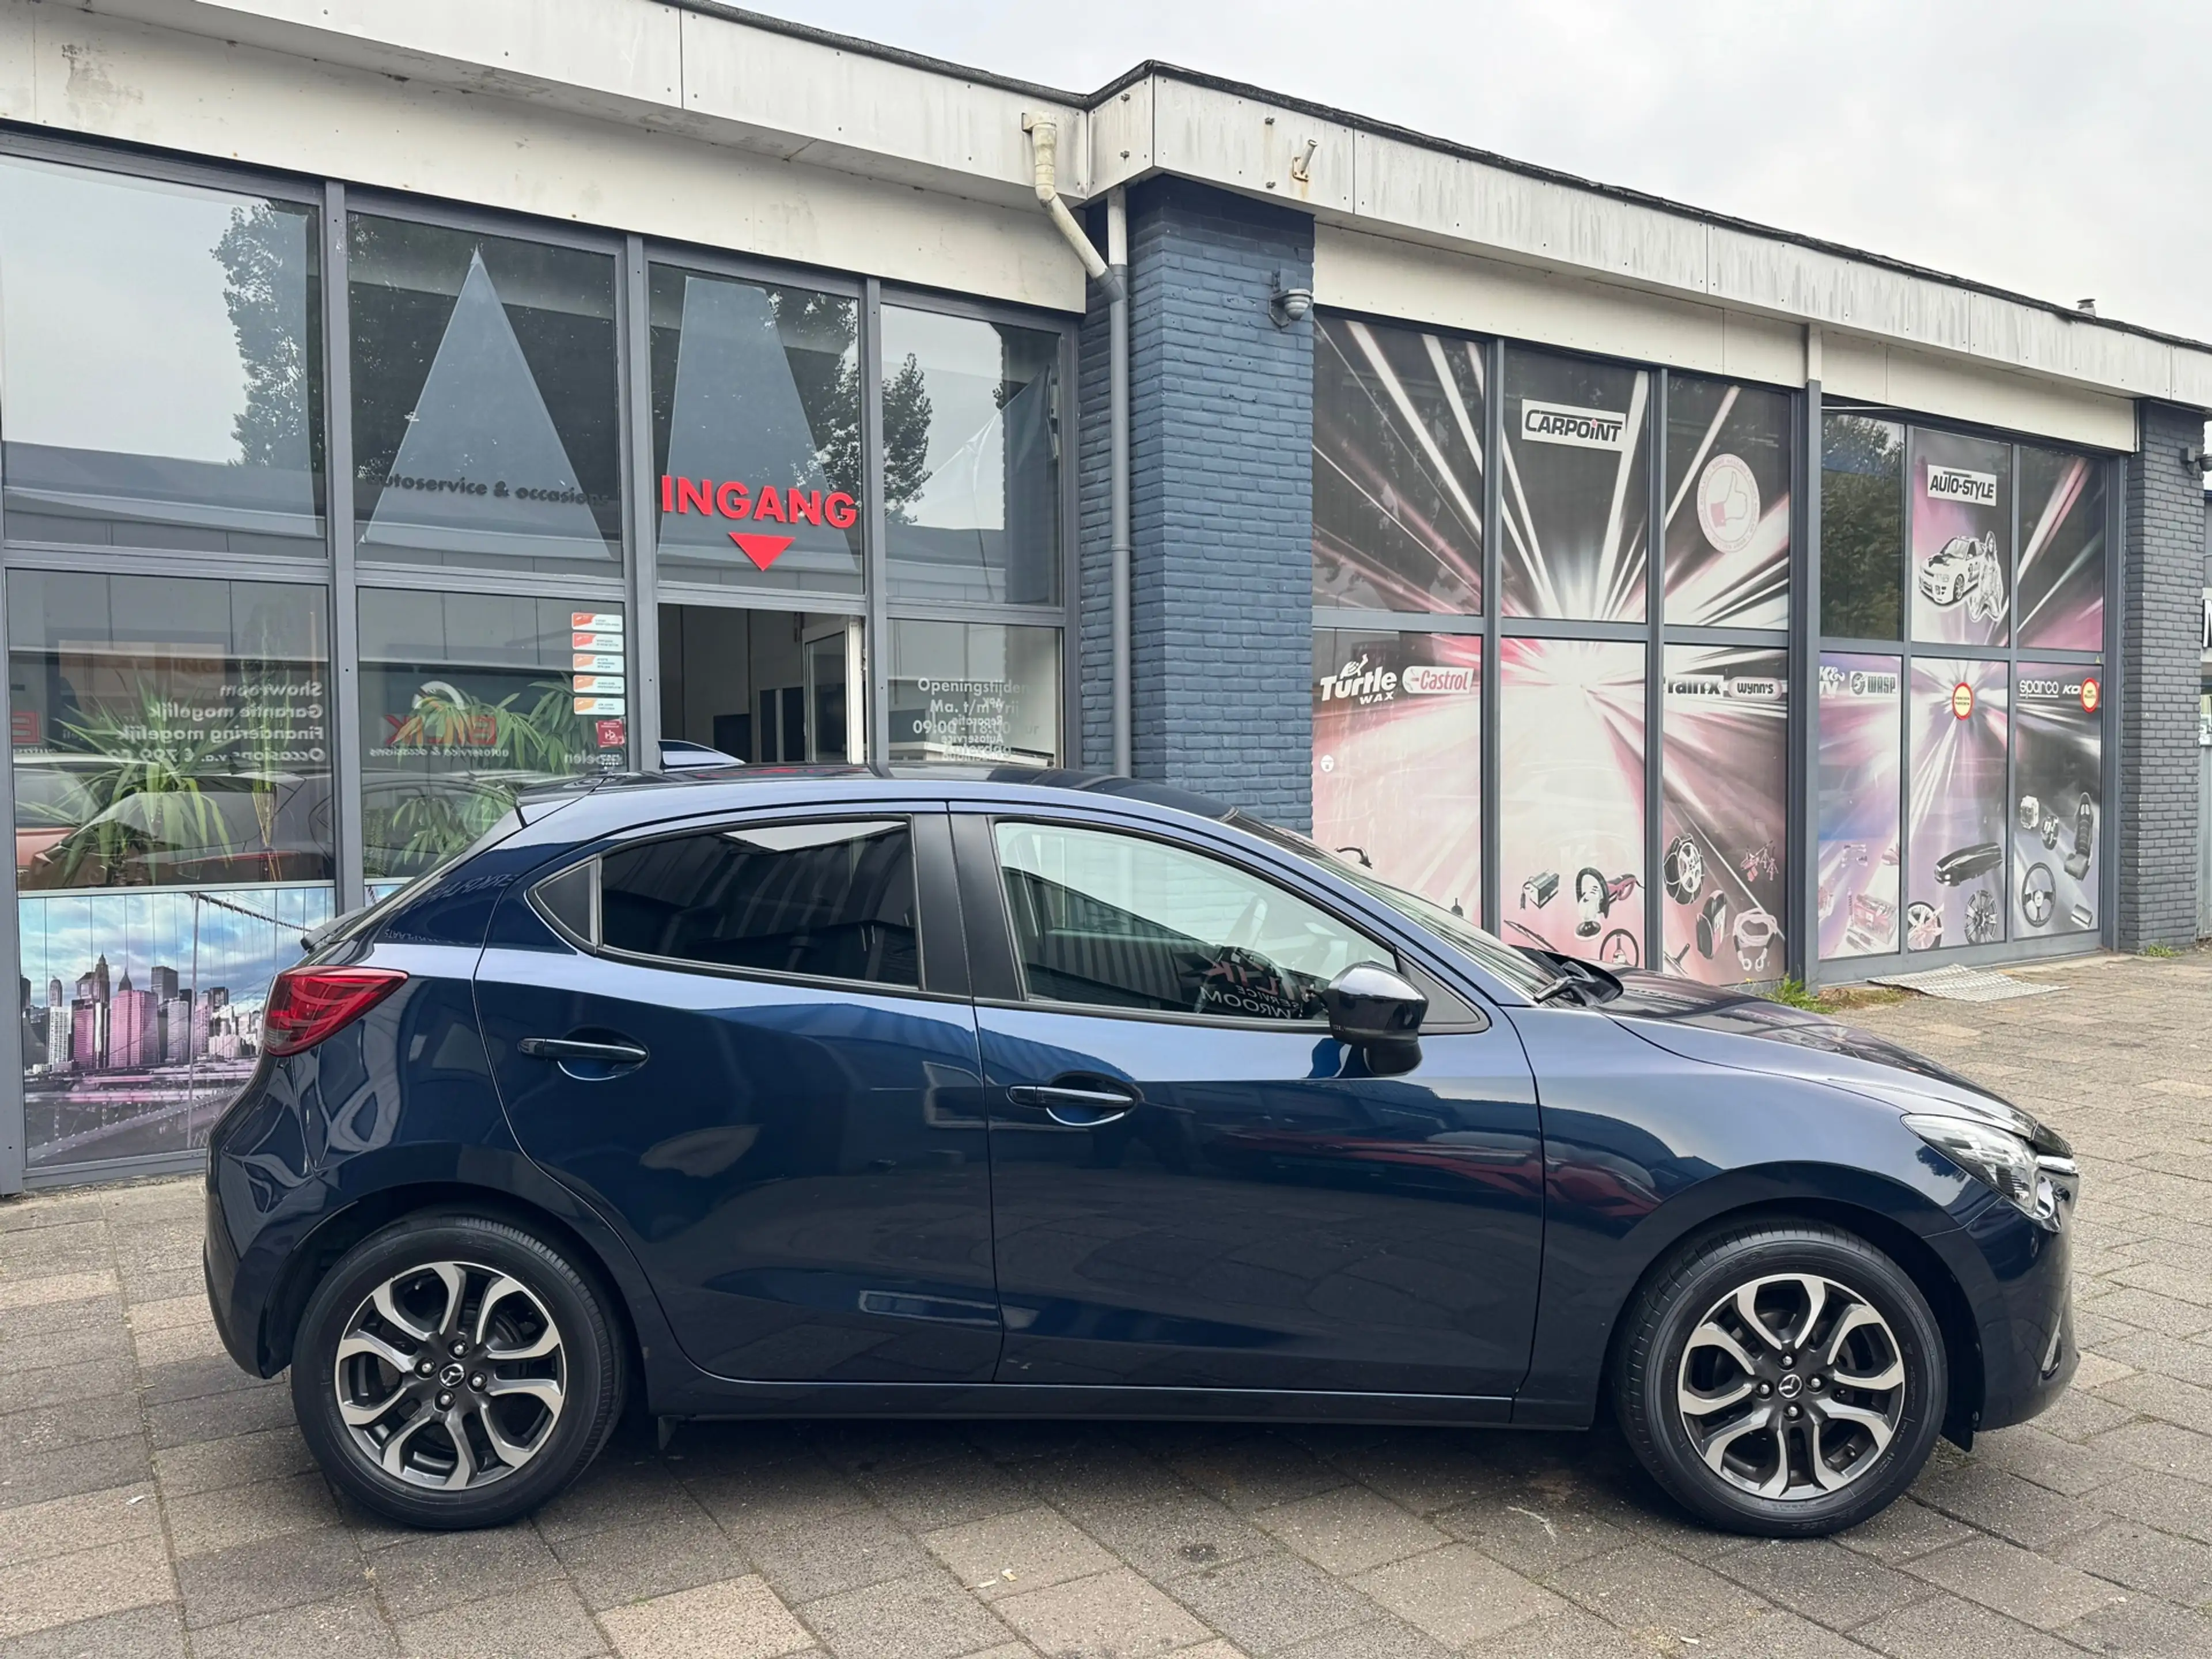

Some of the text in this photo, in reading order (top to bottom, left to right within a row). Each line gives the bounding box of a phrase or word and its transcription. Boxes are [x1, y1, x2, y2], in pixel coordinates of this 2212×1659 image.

[494, 480, 510, 498] &
[515, 486, 611, 506] occasions
[661, 475, 857, 529] INGANG
[918, 677, 1031, 696] Openingstijden
[1320, 665, 1397, 702] Turtle
[1420, 670, 1468, 690] Castrol
[2019, 680, 2059, 699] sparco
[930, 699, 959, 713] Ma.
[963, 699, 989, 715] t/m
[1359, 691, 1394, 705] WAX
[912, 719, 957, 734] 09:00
